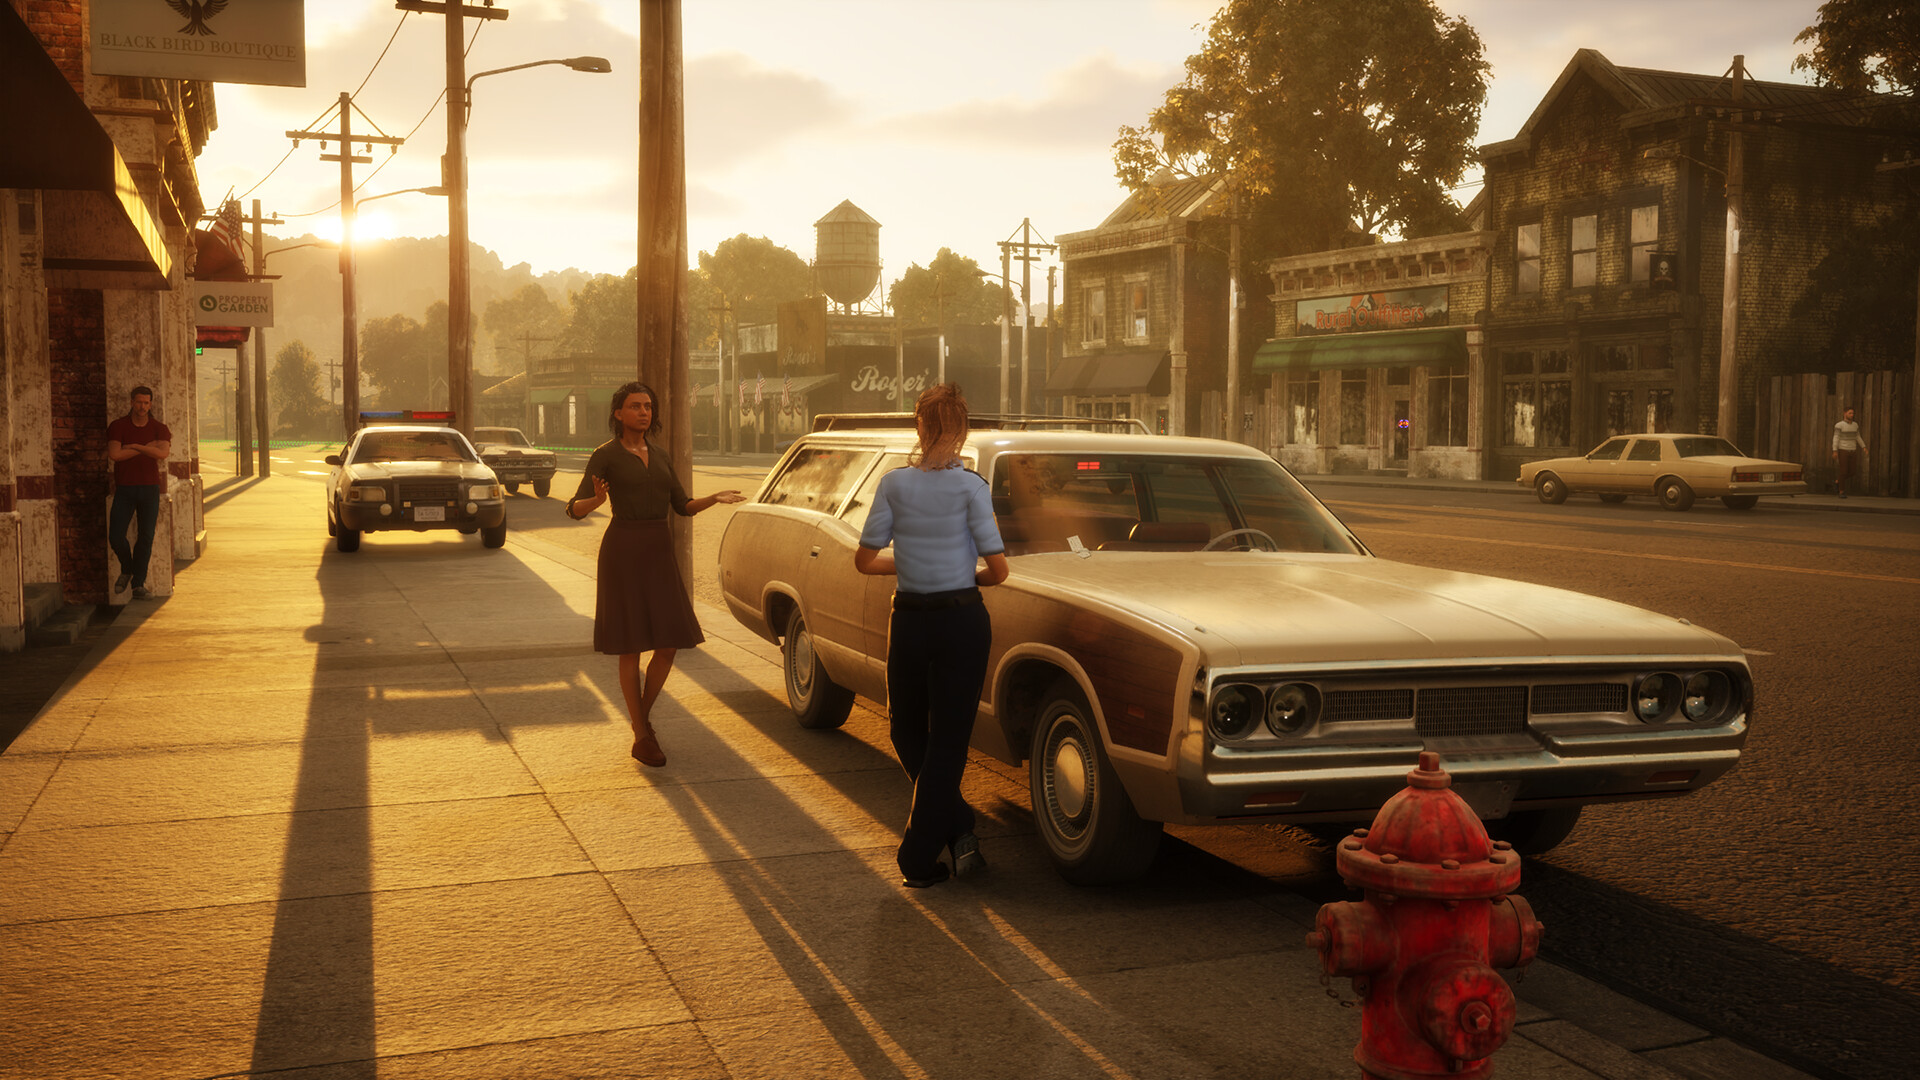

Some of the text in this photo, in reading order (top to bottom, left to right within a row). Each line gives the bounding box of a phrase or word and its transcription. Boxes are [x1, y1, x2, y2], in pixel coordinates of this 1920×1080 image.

[100, 33, 297, 59] BLACK BIRD BOUTIQUE
[219, 295, 269, 304] PROPERTY
[219, 303, 269, 313] GARDEN
[1316, 303, 1425, 330] Rural Outfitters
